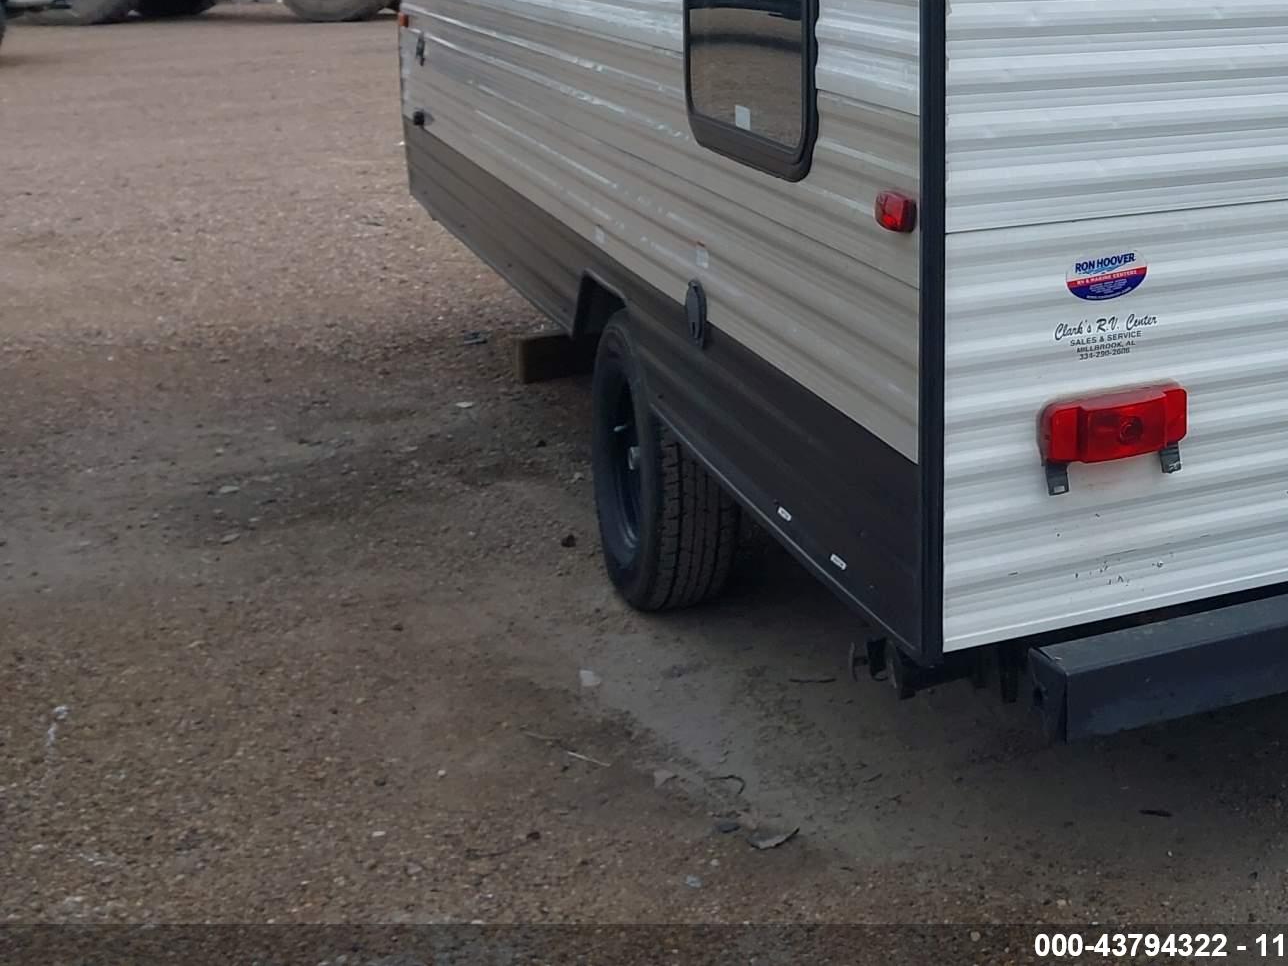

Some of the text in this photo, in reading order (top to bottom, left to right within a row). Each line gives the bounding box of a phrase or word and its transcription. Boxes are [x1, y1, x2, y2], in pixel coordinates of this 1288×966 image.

[1075, 252, 1135, 274] RON HOOVER
[1054, 313, 1158, 341] Clark's R.V. Center
[1070, 330, 1142, 347] SALES & SERVICE
